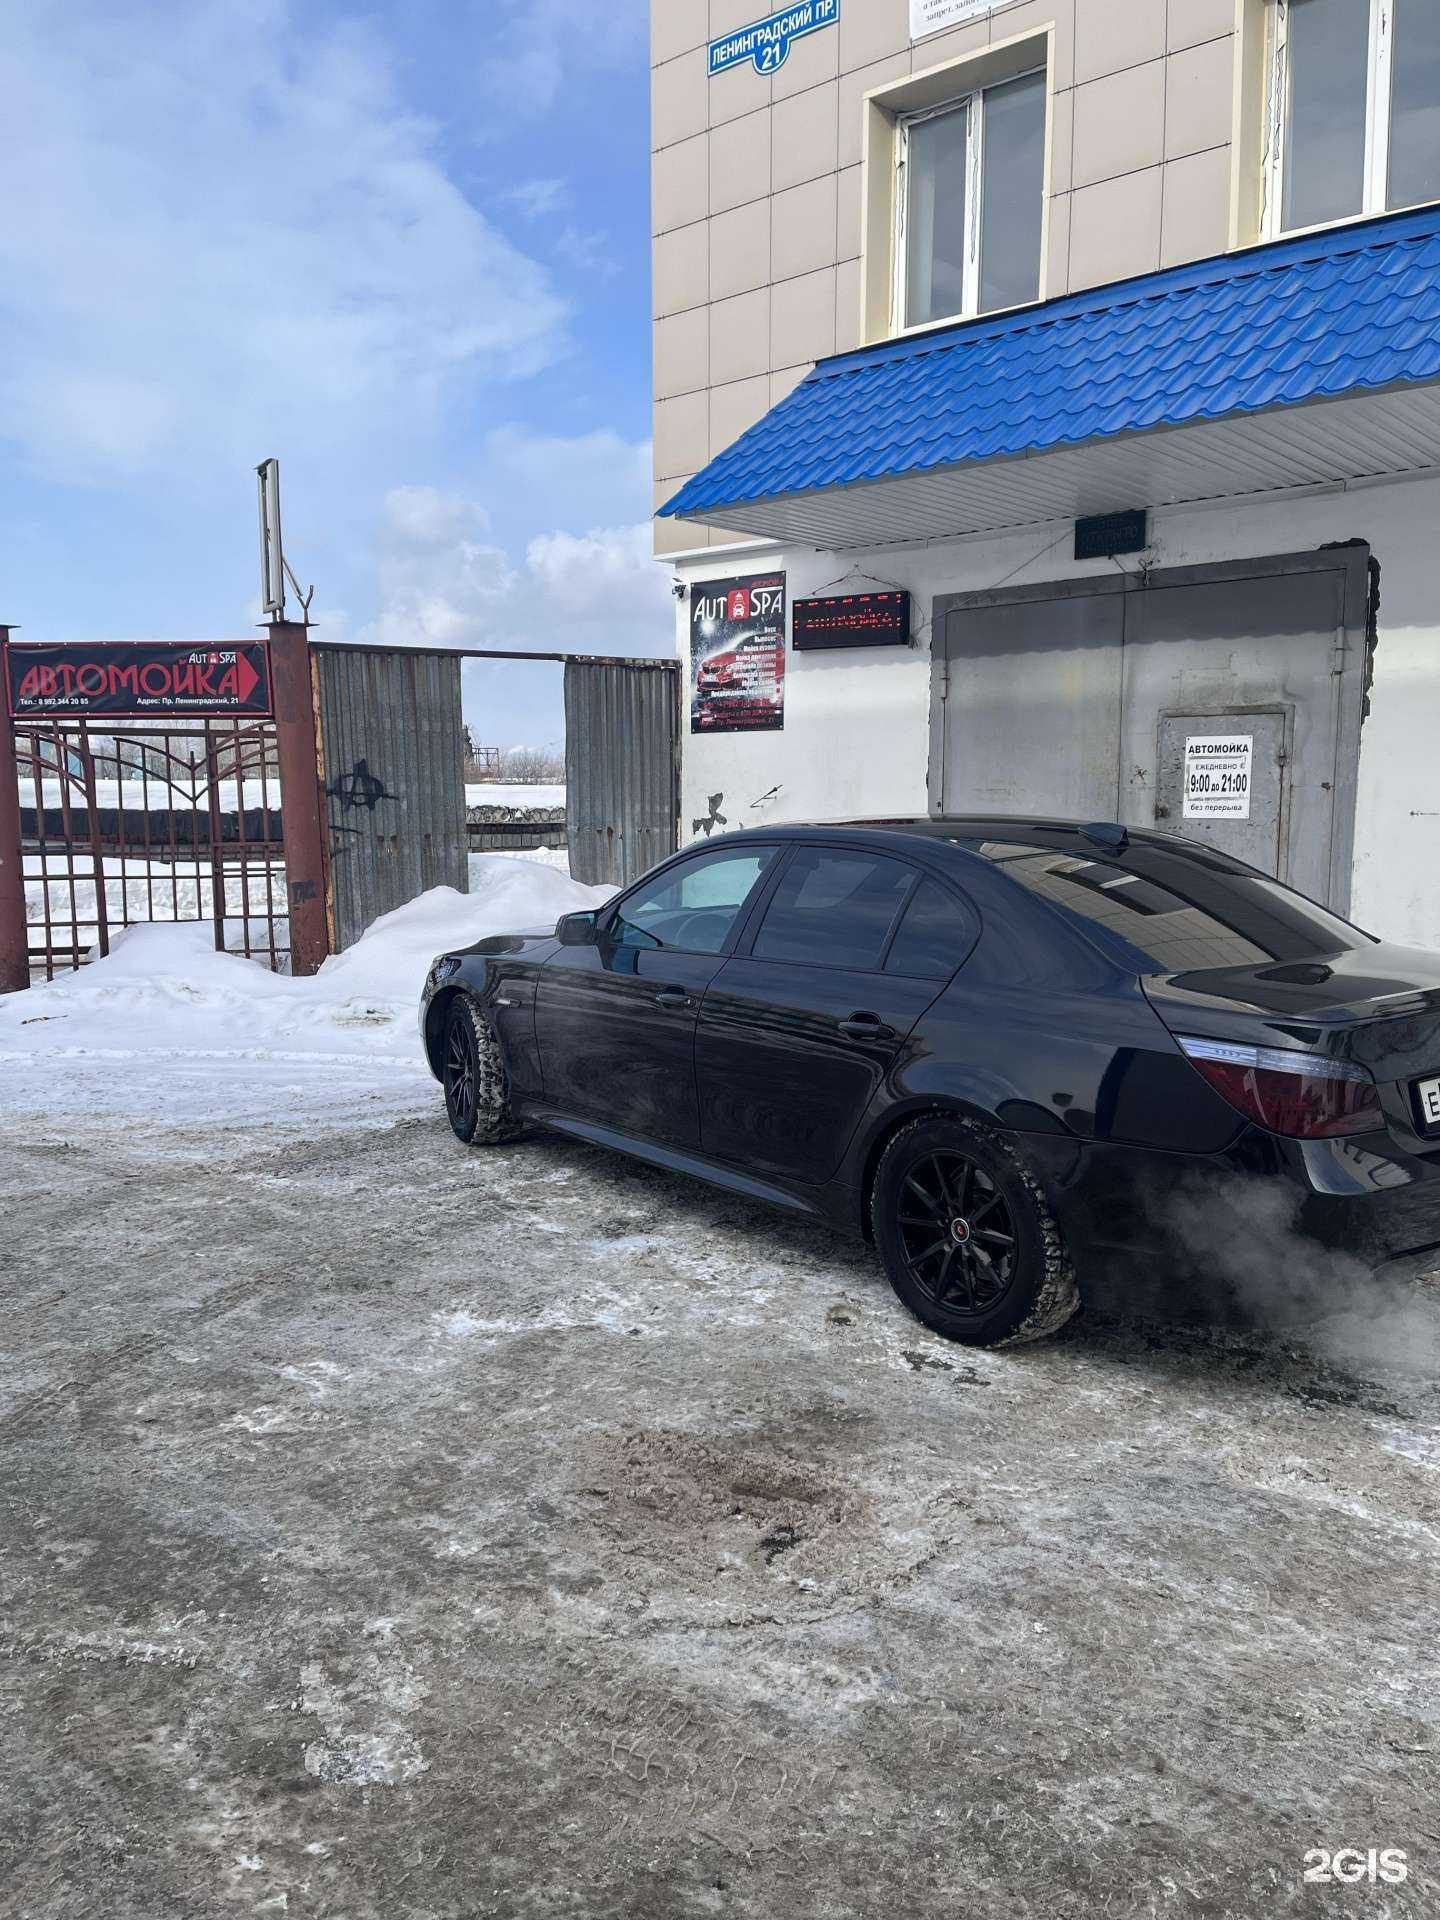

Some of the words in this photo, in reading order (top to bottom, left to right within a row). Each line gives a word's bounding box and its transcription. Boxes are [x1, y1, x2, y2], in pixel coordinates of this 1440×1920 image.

[712, 4, 812, 66] ЛЕНИНГРАДСКИЙ
[762, 42, 781, 70] 21
[19, 659, 238, 696] АВТОМОЙКА
[136, 697, 161, 705] Адрес:
[162, 697, 174, 705] Пр.
[1188, 742, 1249, 754] АВТОМОЙКА
[1195, 763, 1238, 771] ЕЖЕДНЕВНО
[1190, 774, 1210, 792] 9:00
[1211, 783, 1220, 792] до
[1221, 773, 1248, 792] 21:00
[1190, 803, 1203, 811] без
[1204, 804, 1243, 812] перерыва
